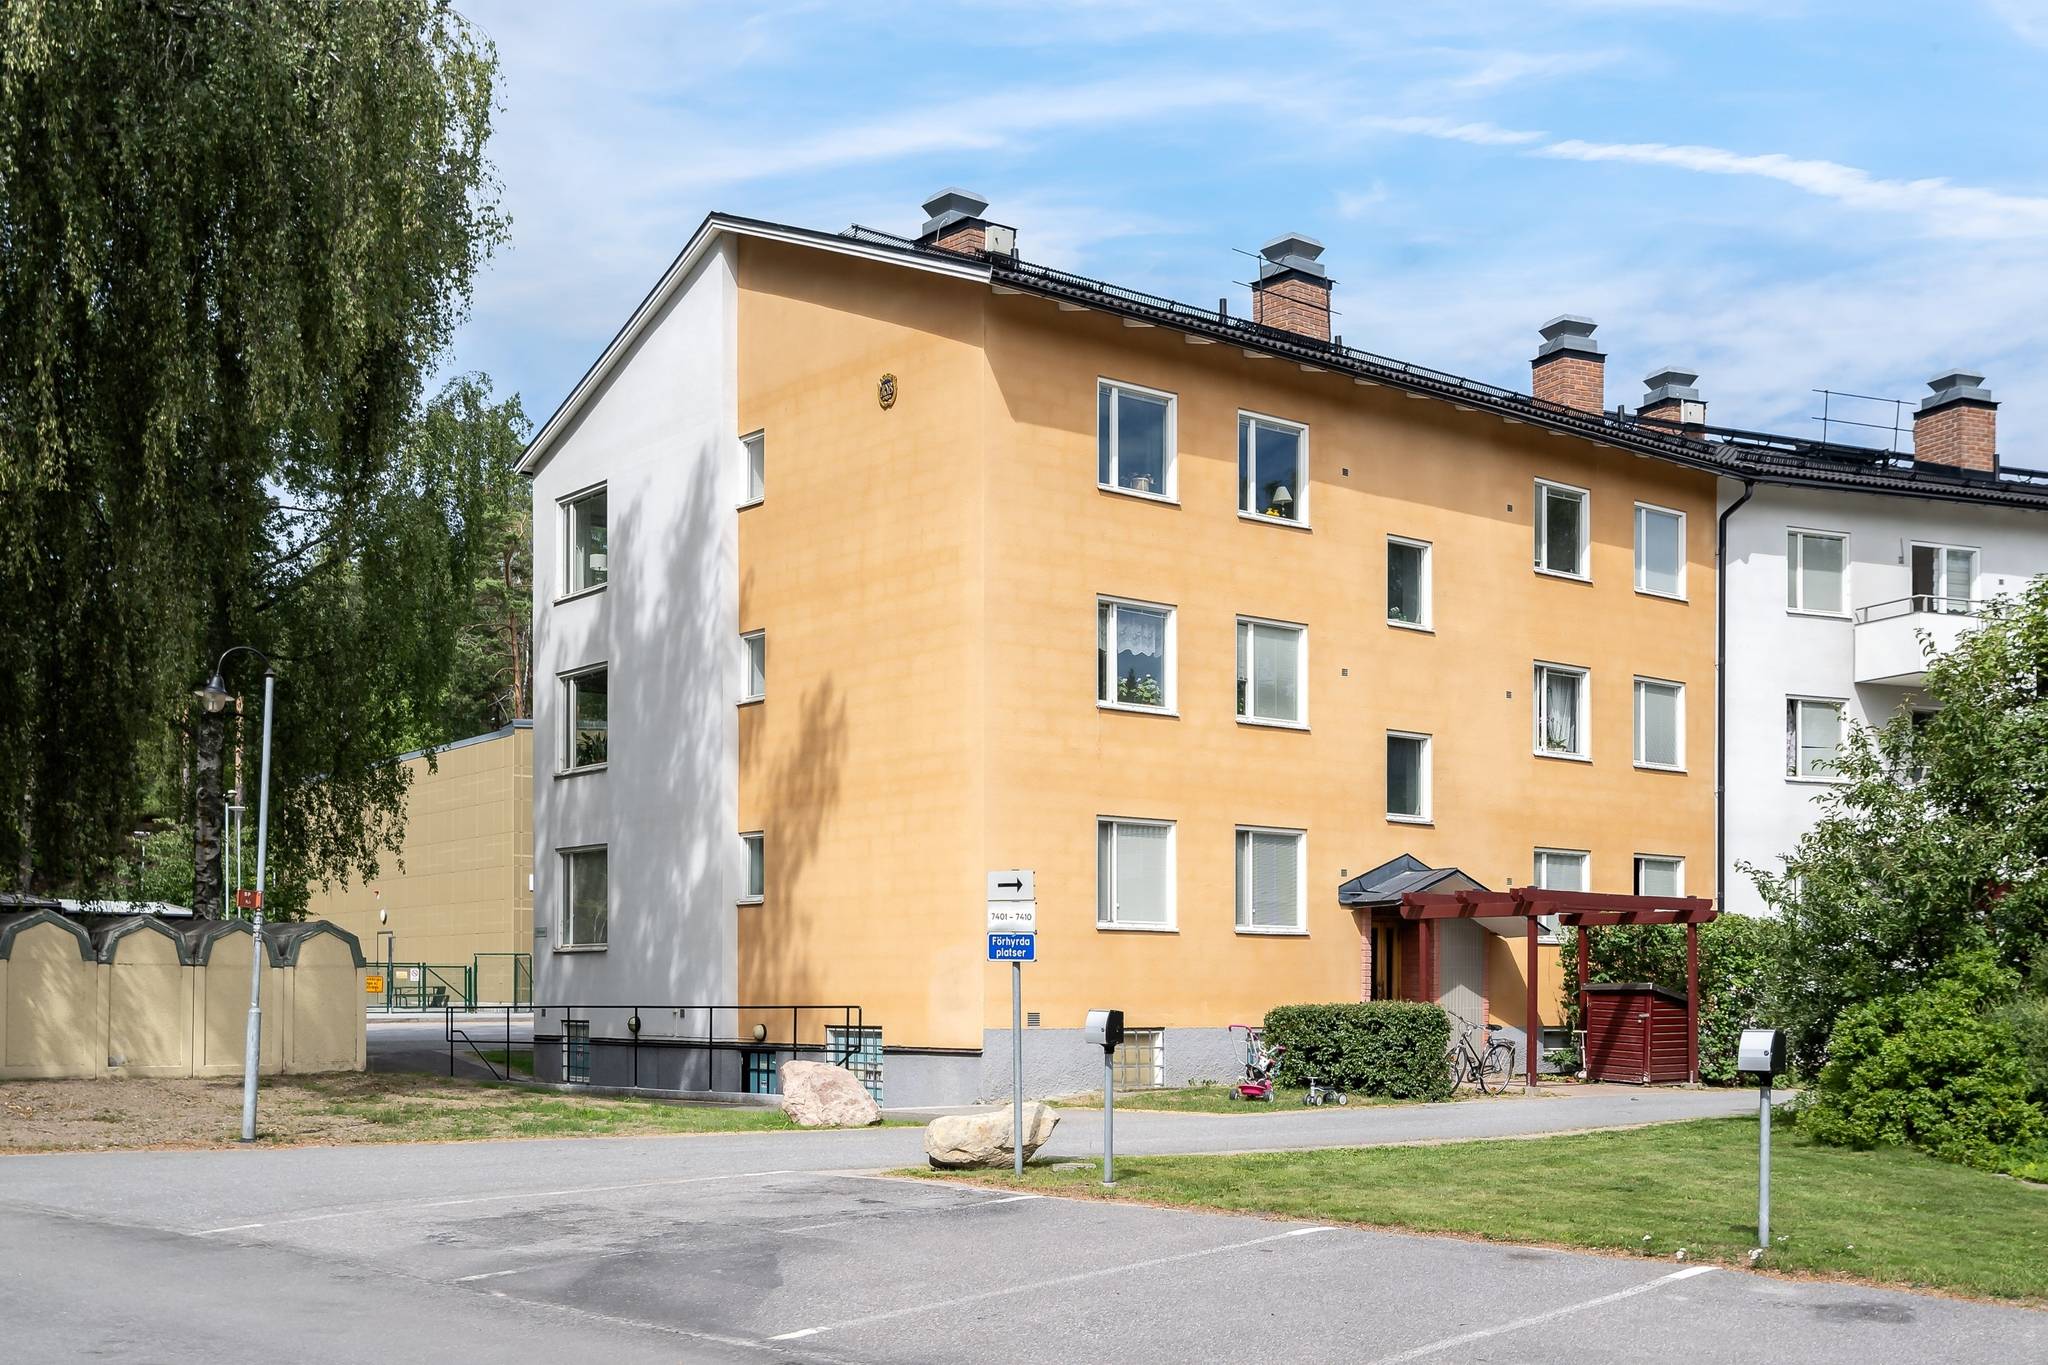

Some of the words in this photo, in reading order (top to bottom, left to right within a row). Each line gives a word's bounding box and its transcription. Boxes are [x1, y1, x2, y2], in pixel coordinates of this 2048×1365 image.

[991, 912, 1008, 921] 7401
[1015, 912, 1032, 921] 7410
[992, 936, 1030, 948] Förhyrda
[996, 947, 1026, 959] platser
